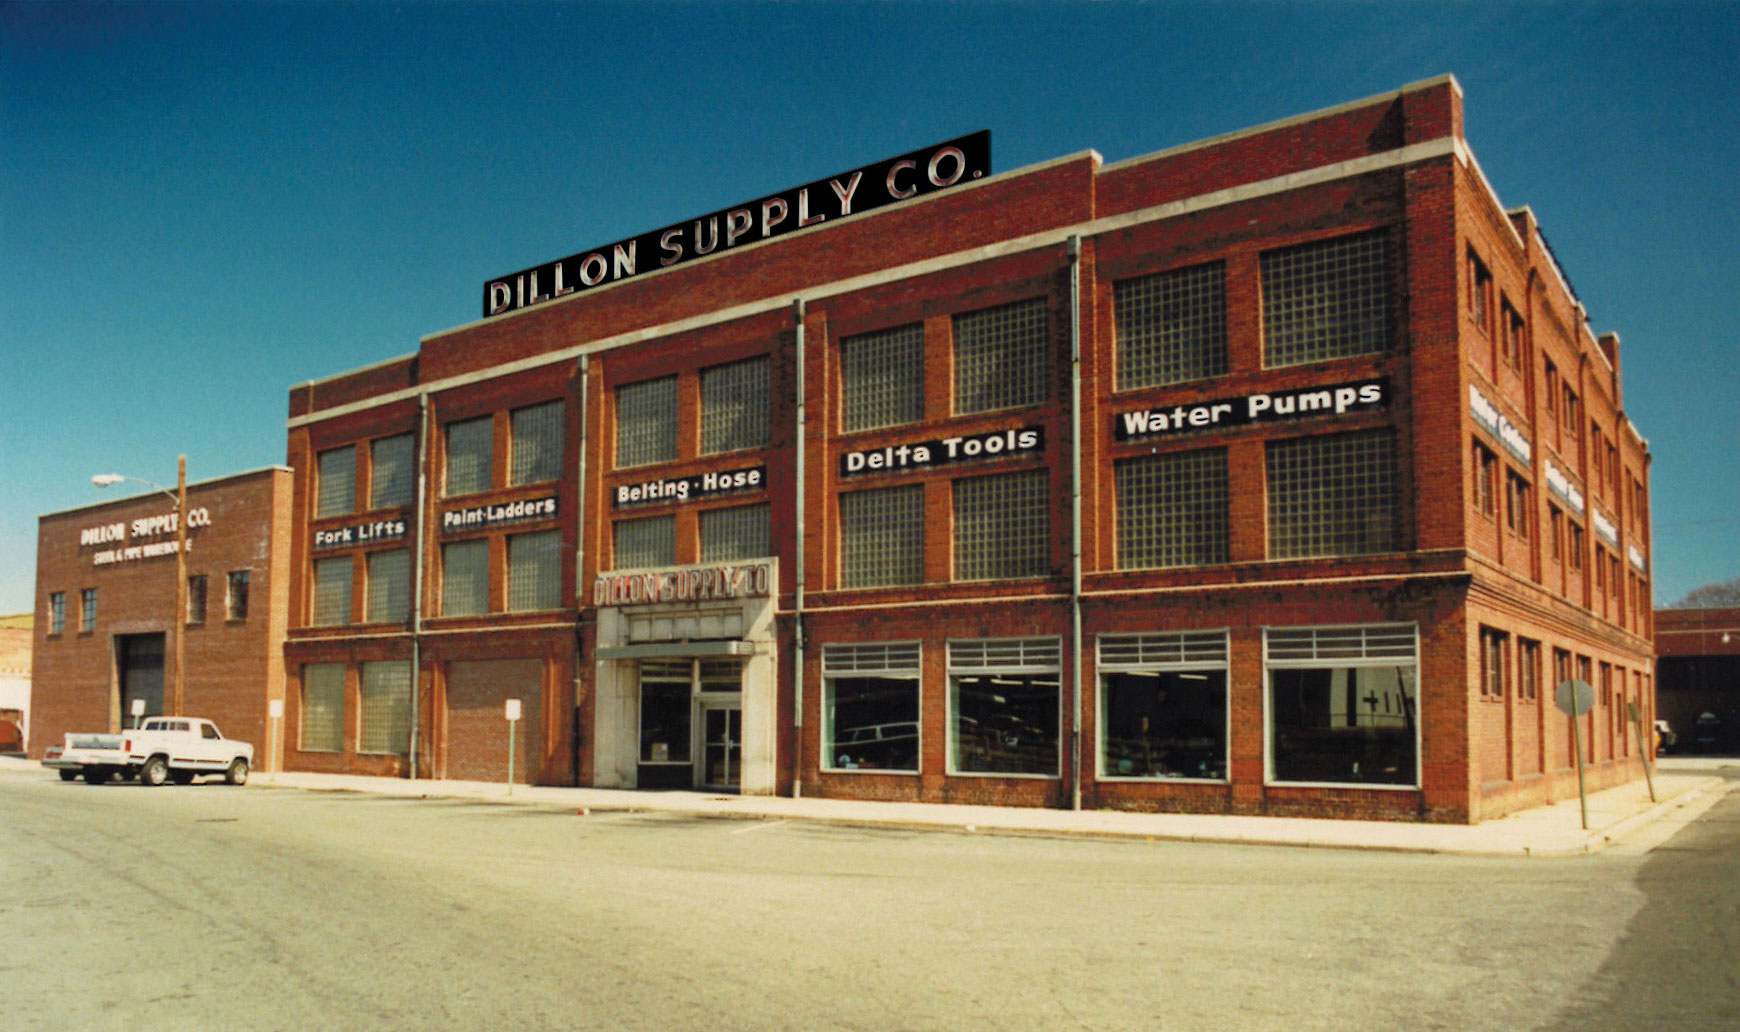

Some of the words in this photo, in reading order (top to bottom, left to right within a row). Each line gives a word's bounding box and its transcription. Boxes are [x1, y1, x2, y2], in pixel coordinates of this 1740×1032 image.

[490, 241, 637, 315] DILLON
[660, 171, 863, 267] SUPPLY
[886, 146, 984, 200] CO.
[1124, 403, 1232, 435] Water
[1249, 384, 1382, 418] Pumps
[847, 443, 930, 471] Delta
[943, 429, 1038, 456] Tools
[618, 480, 689, 503] Belting
[703, 469, 760, 491] Hose
[81, 523, 125, 545] DILLON
[131, 513, 179, 537] SUPPLY
[187, 508, 211, 528] CO.
[316, 527, 352, 545] Fork
[359, 521, 405, 540] Lifts
[594, 574, 660, 606] DILLON
[662, 566, 741, 599] SUPPLY
